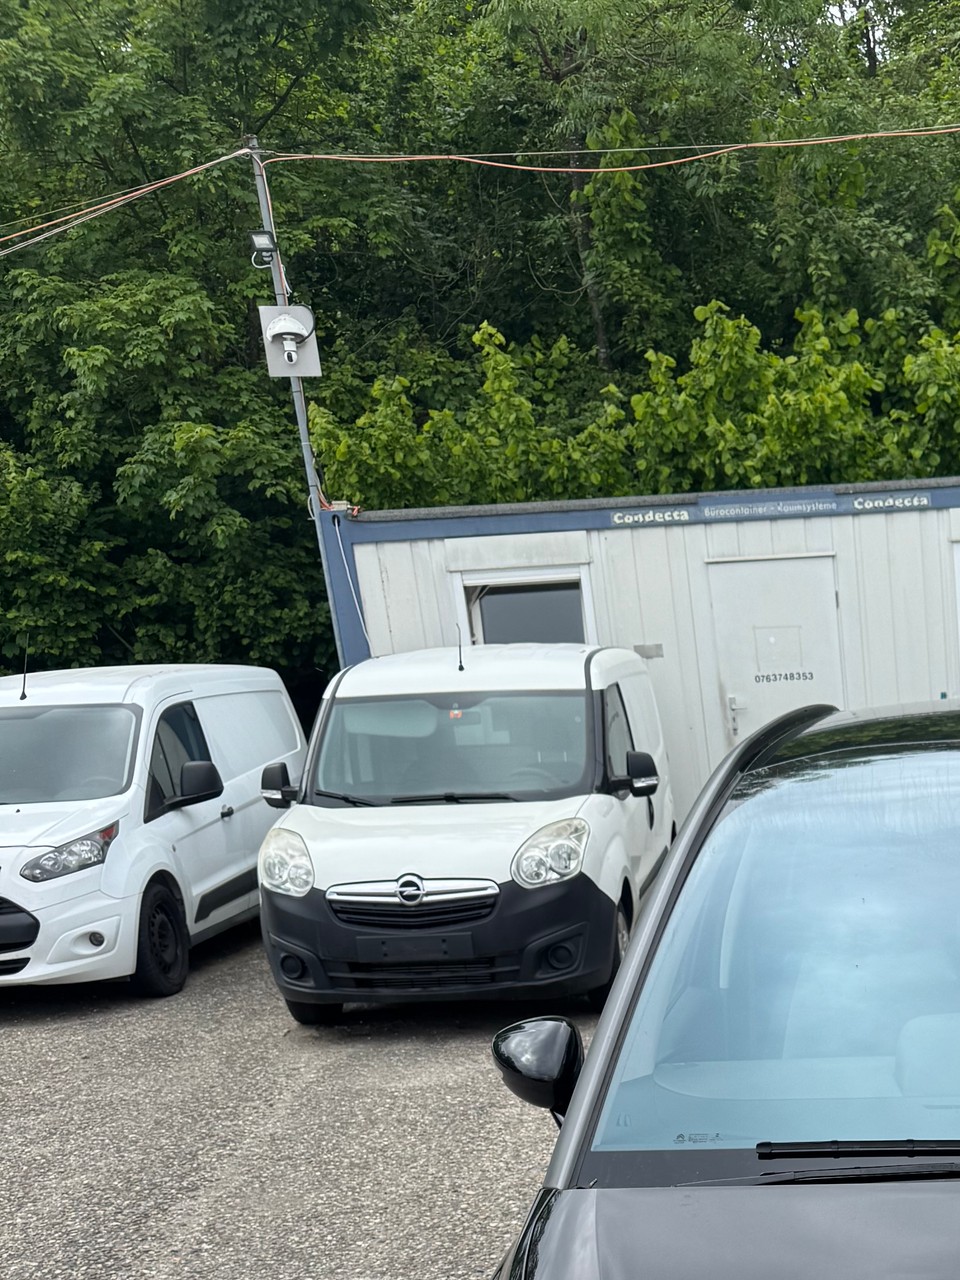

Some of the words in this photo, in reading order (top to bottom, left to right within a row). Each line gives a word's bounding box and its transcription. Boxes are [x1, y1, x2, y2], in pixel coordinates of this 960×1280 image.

[853, 496, 928, 510] Condecta
[613, 509, 689, 524] Condecta
[754, 671, 814, 683] 0763748353
